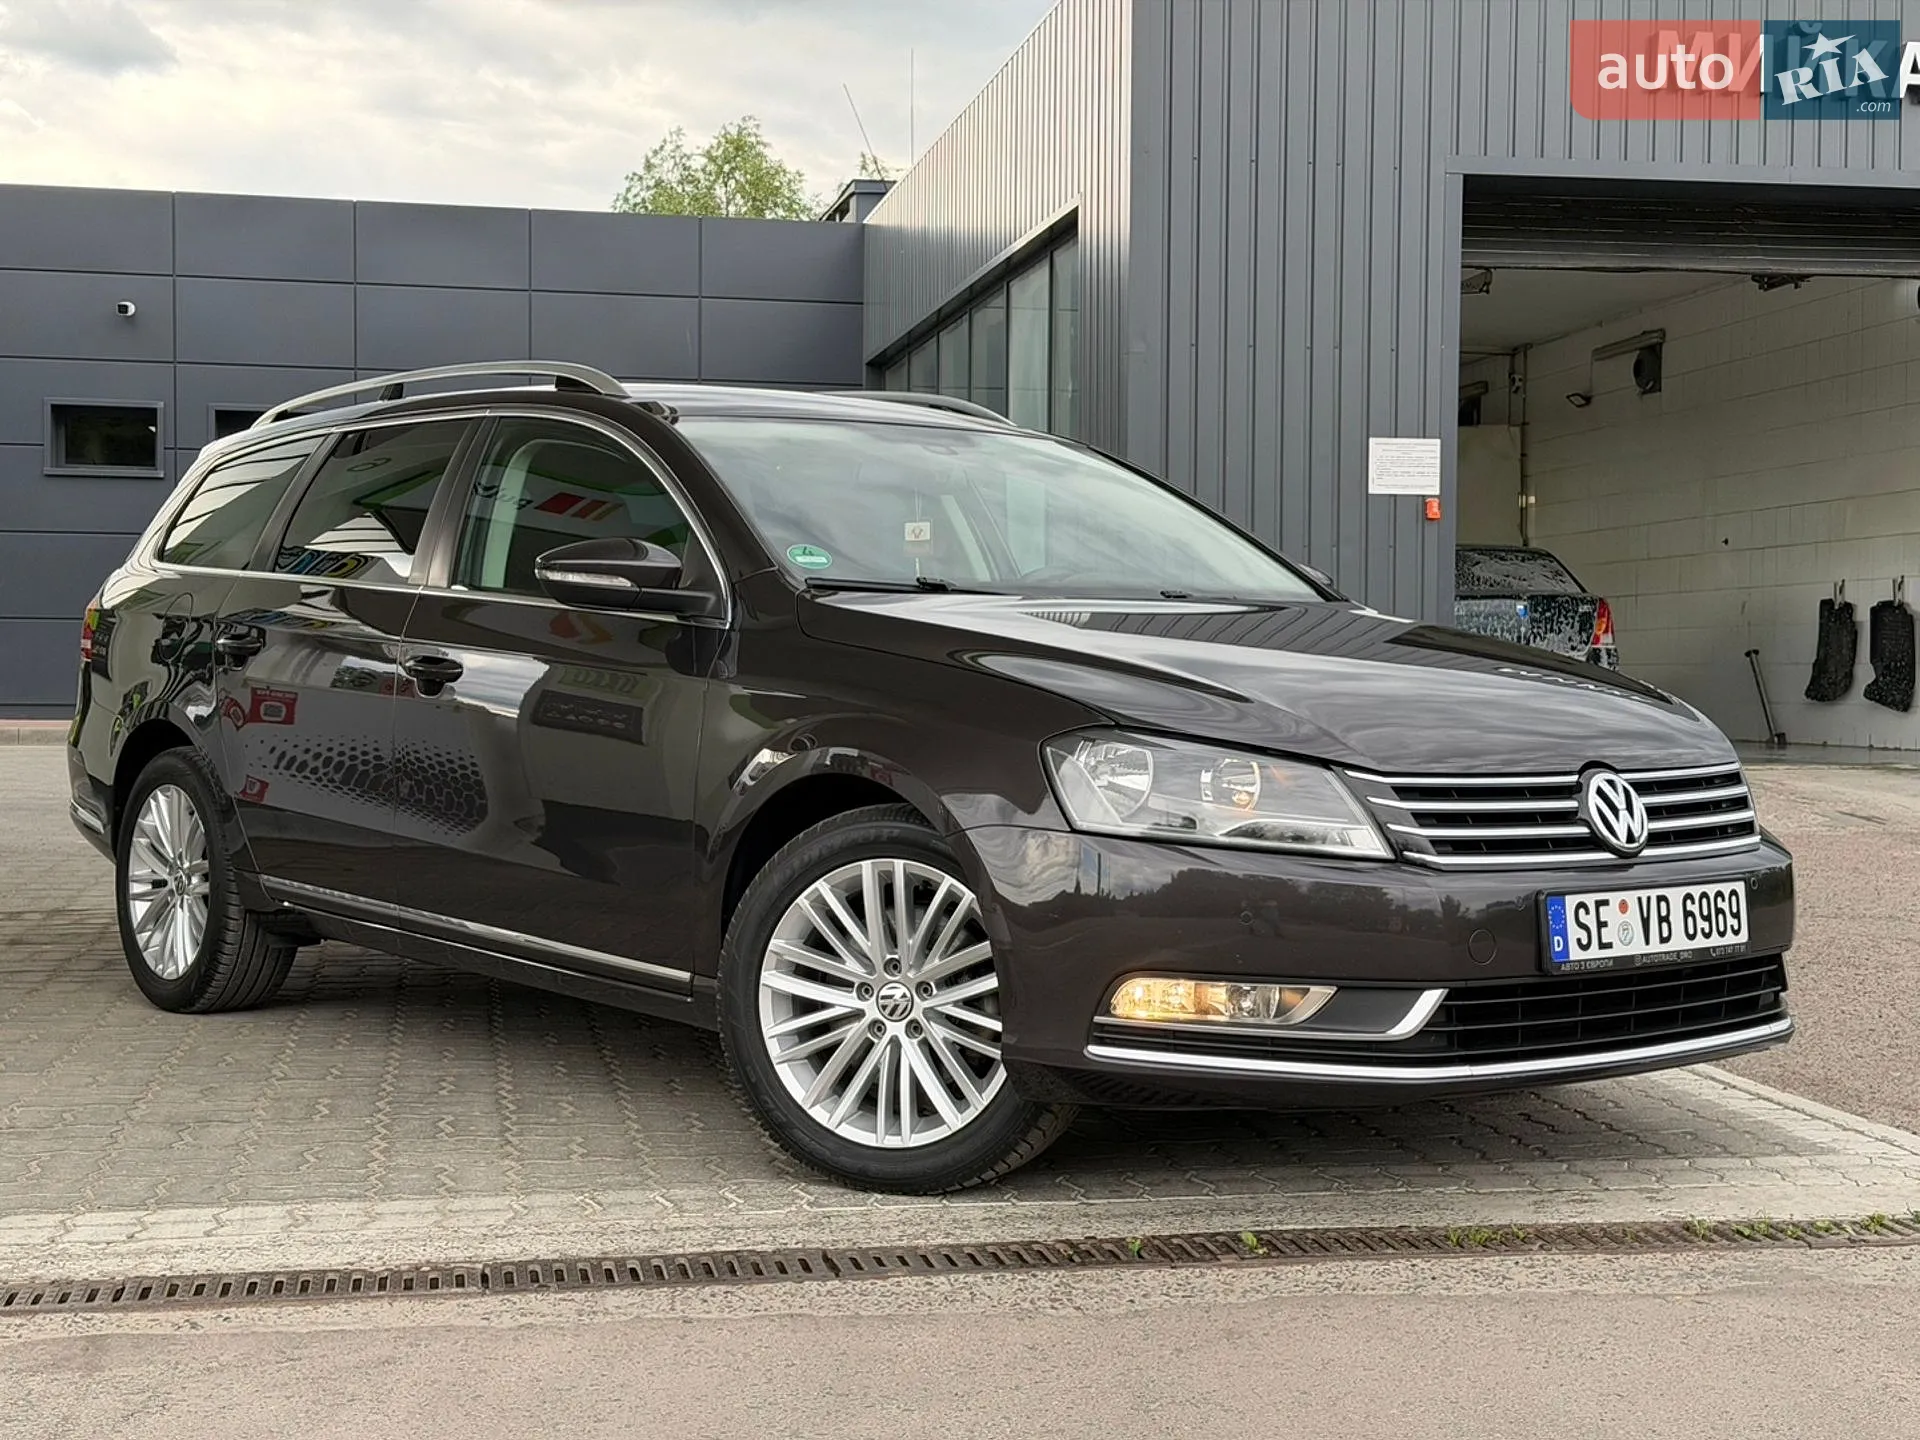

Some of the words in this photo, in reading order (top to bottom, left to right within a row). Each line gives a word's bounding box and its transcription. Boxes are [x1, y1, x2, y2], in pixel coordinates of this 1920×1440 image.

[1573, 899, 1614, 951] SE
[1637, 894, 1672, 946] VB
[1682, 888, 1742, 942] 6969
[1554, 936, 1563, 952] D
